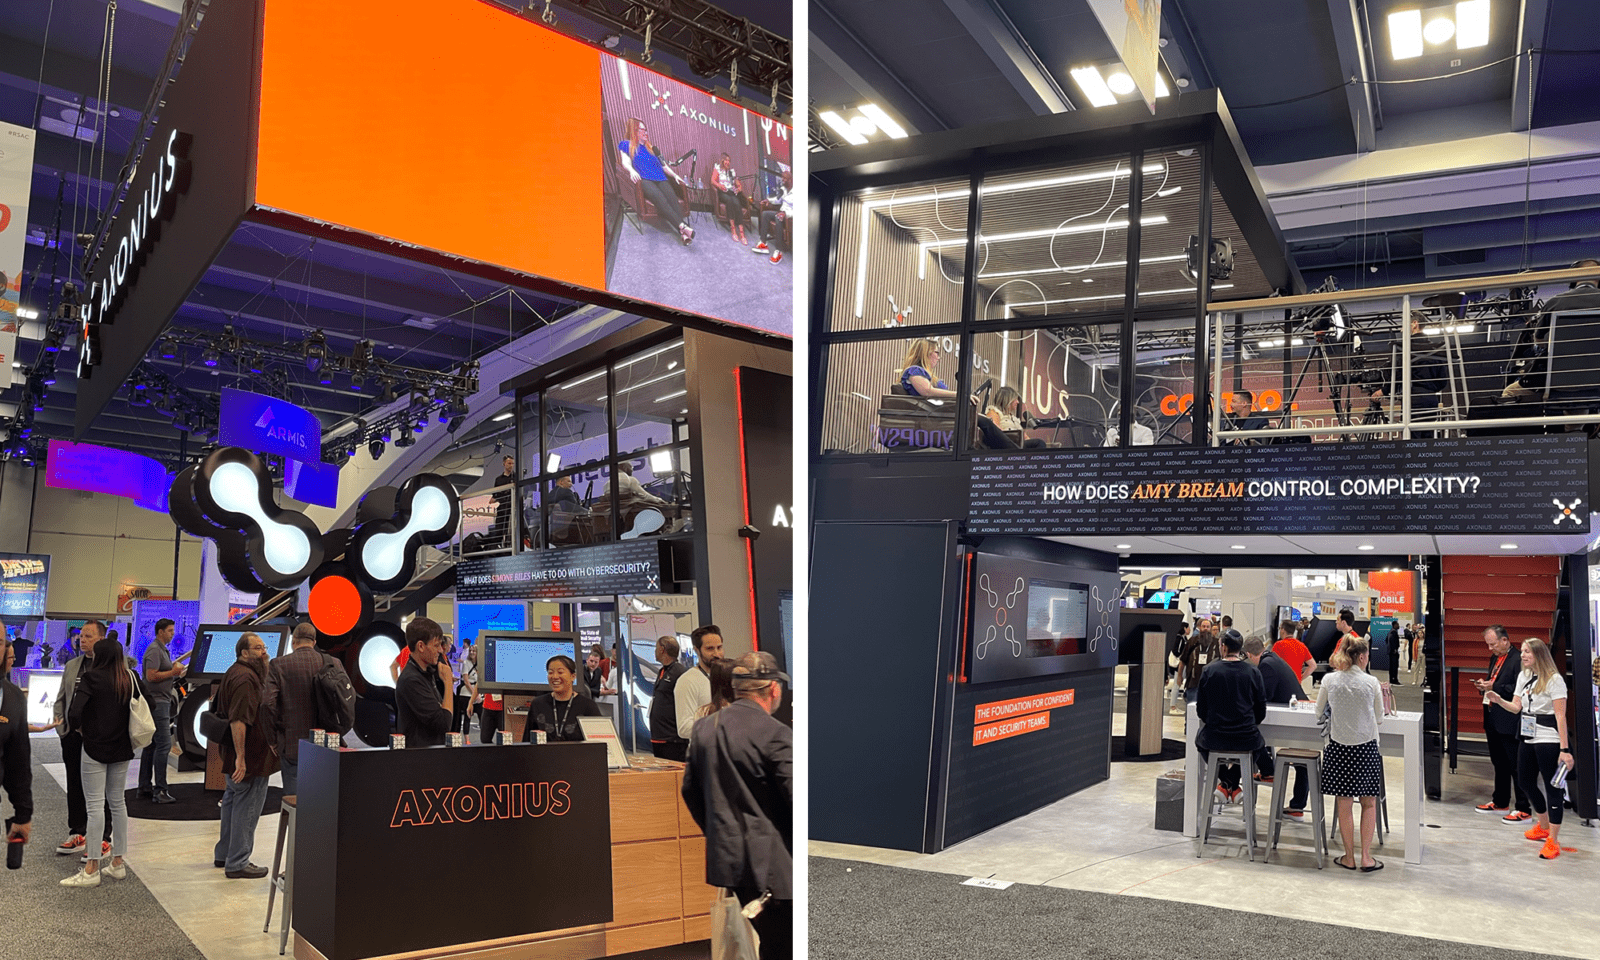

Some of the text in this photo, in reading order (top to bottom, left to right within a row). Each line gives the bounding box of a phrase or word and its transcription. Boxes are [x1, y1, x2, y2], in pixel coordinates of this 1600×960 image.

[680, 104, 736, 137] AXONIUS
[99, 128, 177, 324] AXONIUS
[1043, 476, 1481, 501] HOW DOES AMY BREAM CONTROL COMPLEXITY?
[478, 575, 491, 584] DOES
[514, 571, 531, 582] BILES
[531, 570, 547, 580] HAVE
[548, 570, 557, 579] TO
[557, 569, 567, 578] DO
[568, 567, 585, 577] WITH
[586, 562, 651, 576] CYBERSECURITY?
[977, 693, 1073, 719] THE FOUNDATION FOR CONFIDENT
[975, 716, 1047, 741] IT AND SECURITY TEAMS.
[389, 780, 571, 828] AXONIUS
